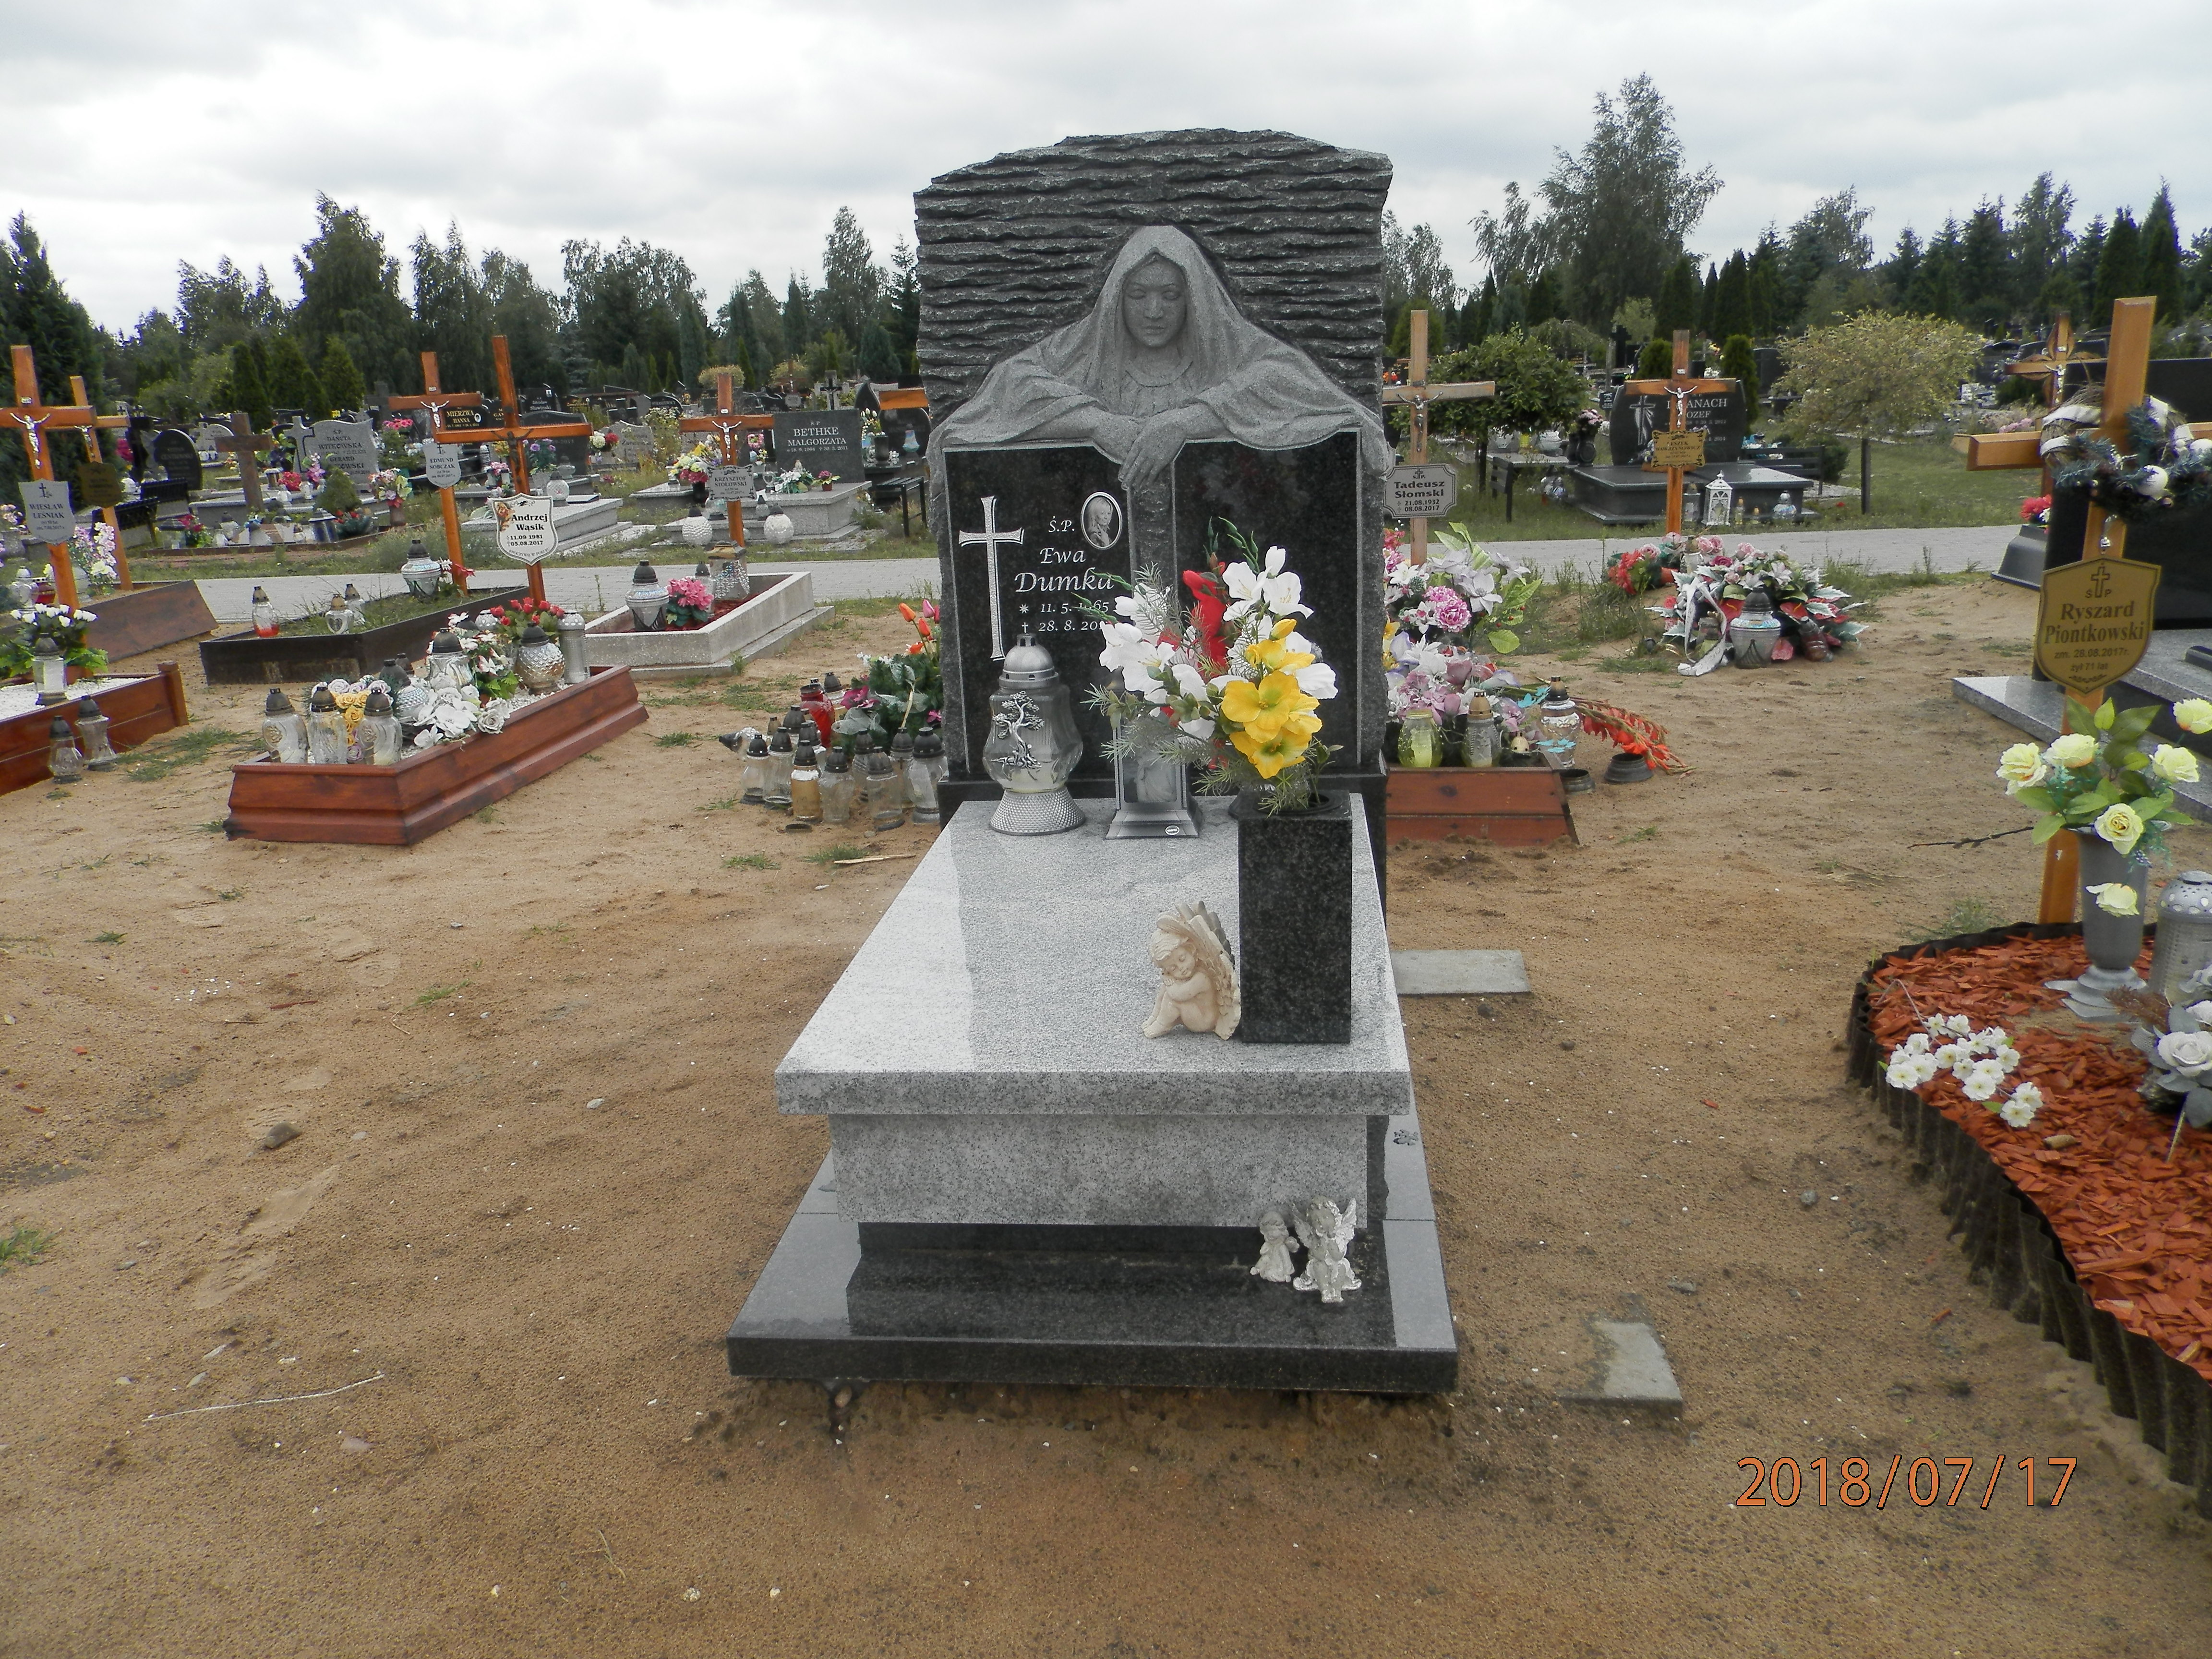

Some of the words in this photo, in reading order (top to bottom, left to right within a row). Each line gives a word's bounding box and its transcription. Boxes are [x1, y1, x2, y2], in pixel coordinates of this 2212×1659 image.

[793, 427, 839, 437] BETHKE
[1394, 481, 1445, 489] Tadeusz
[1395, 489, 1444, 498] Słomski
[512, 514, 548, 523] Andrzej
[516, 523, 544, 532] Wąsik
[1048, 516, 1075, 533] Ś.P.
[1040, 548, 1086, 564] Ewa
[1041, 603, 1056, 613] 11.
[1061, 603, 1072, 614] 5.
[2061, 601, 2134, 624] Ryszard
[1038, 620, 1058, 632] 28.
[1064, 619, 1076, 631] 8.
[2044, 621, 2144, 644] Piontkowski
